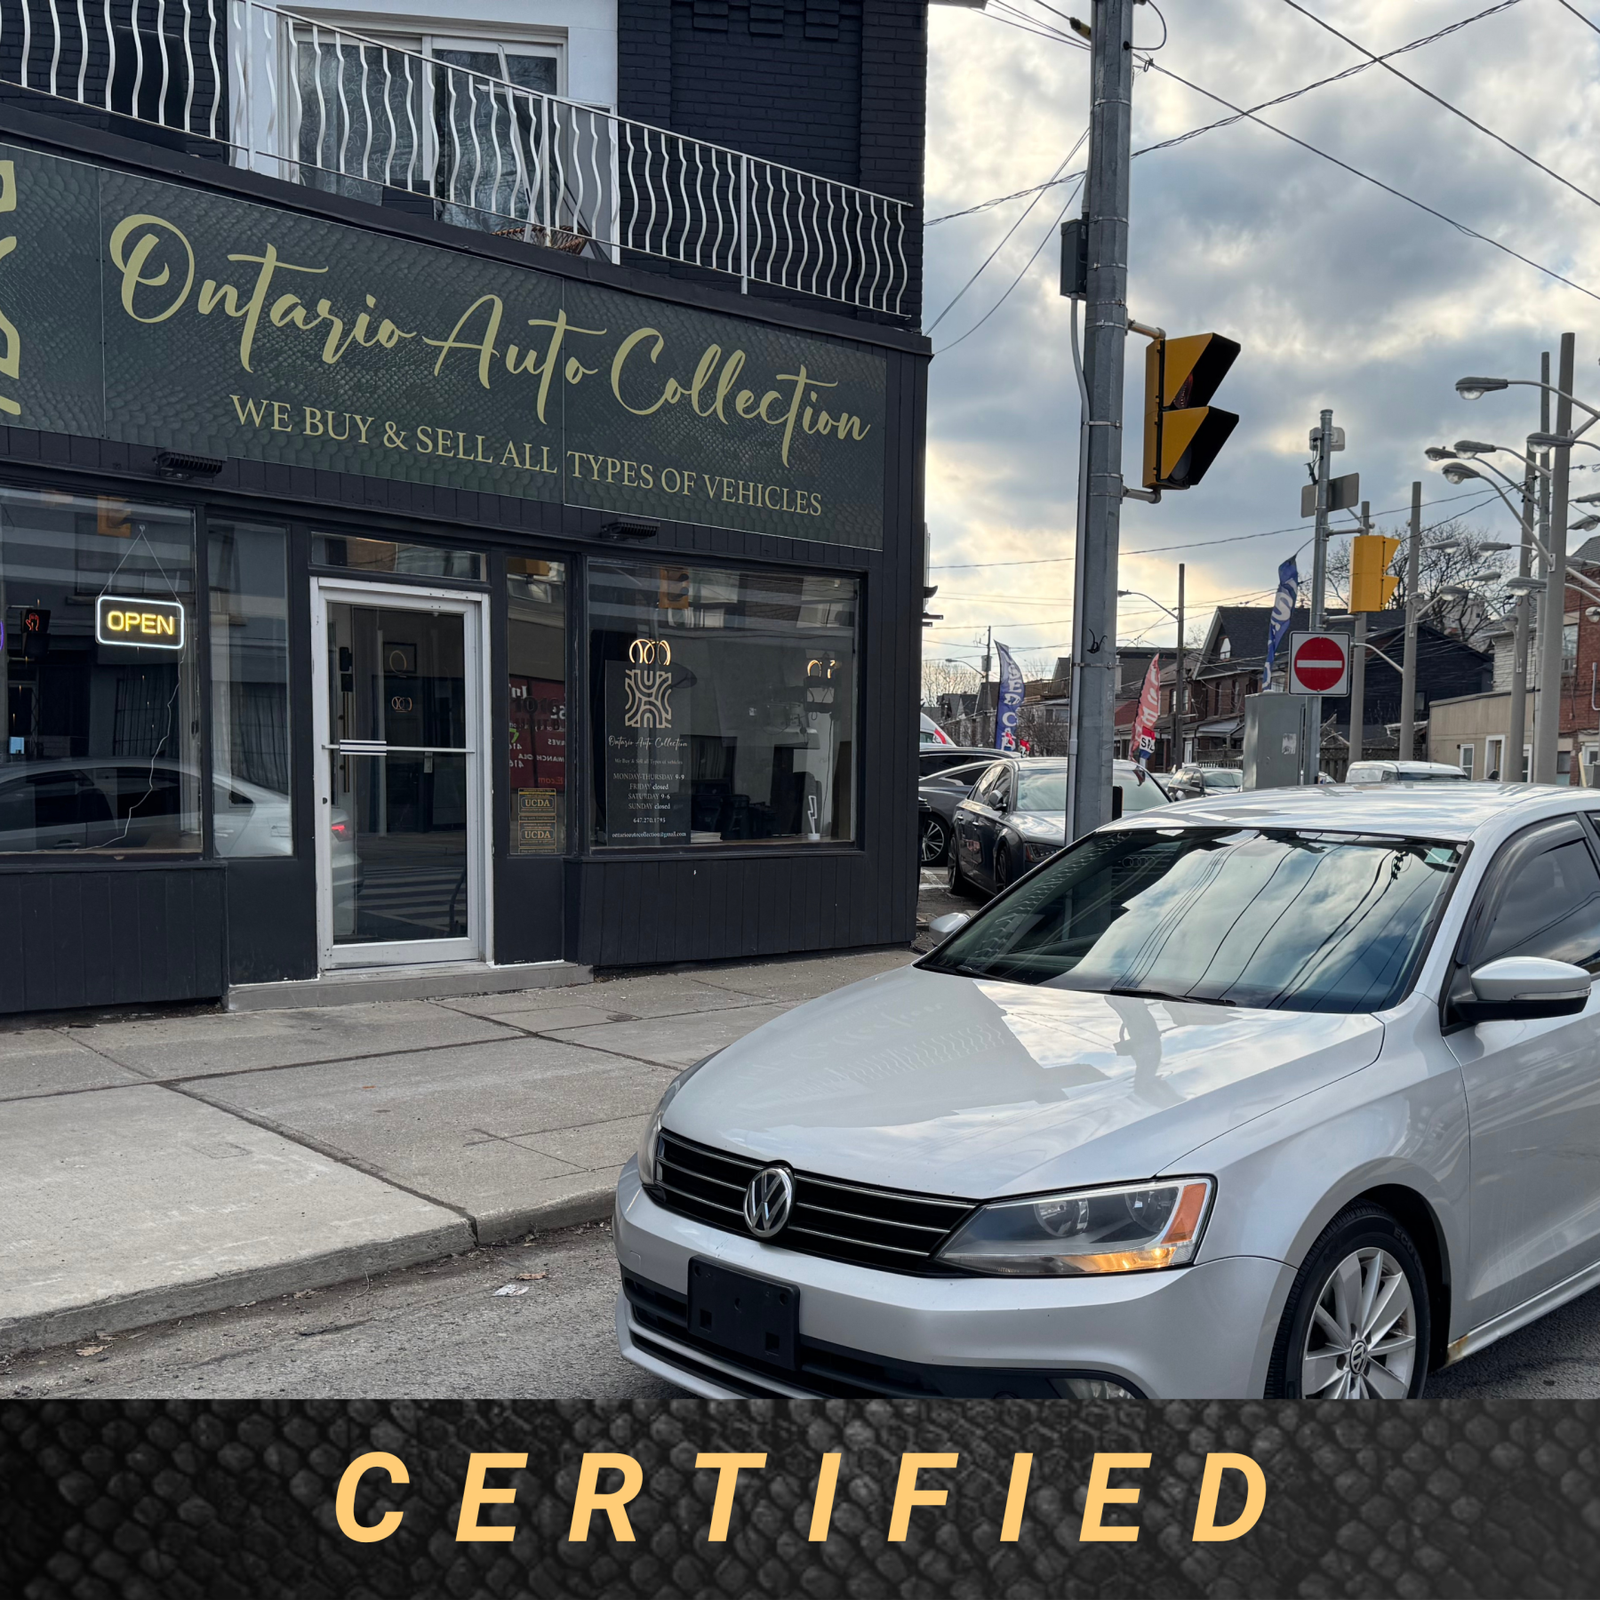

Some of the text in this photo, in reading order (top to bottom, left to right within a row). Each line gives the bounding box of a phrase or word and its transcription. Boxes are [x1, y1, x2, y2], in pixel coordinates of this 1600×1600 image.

[109, 214, 871, 467] Ontario Auto Collection
[229, 394, 822, 516] WE BUY & SELL ALL TYPES OF VEHICLES
[107, 611, 175, 635] OPEN
[655, 737, 688, 751] Collection
[525, 799, 550, 807] UCDA
[524, 831, 551, 839] UCDA
